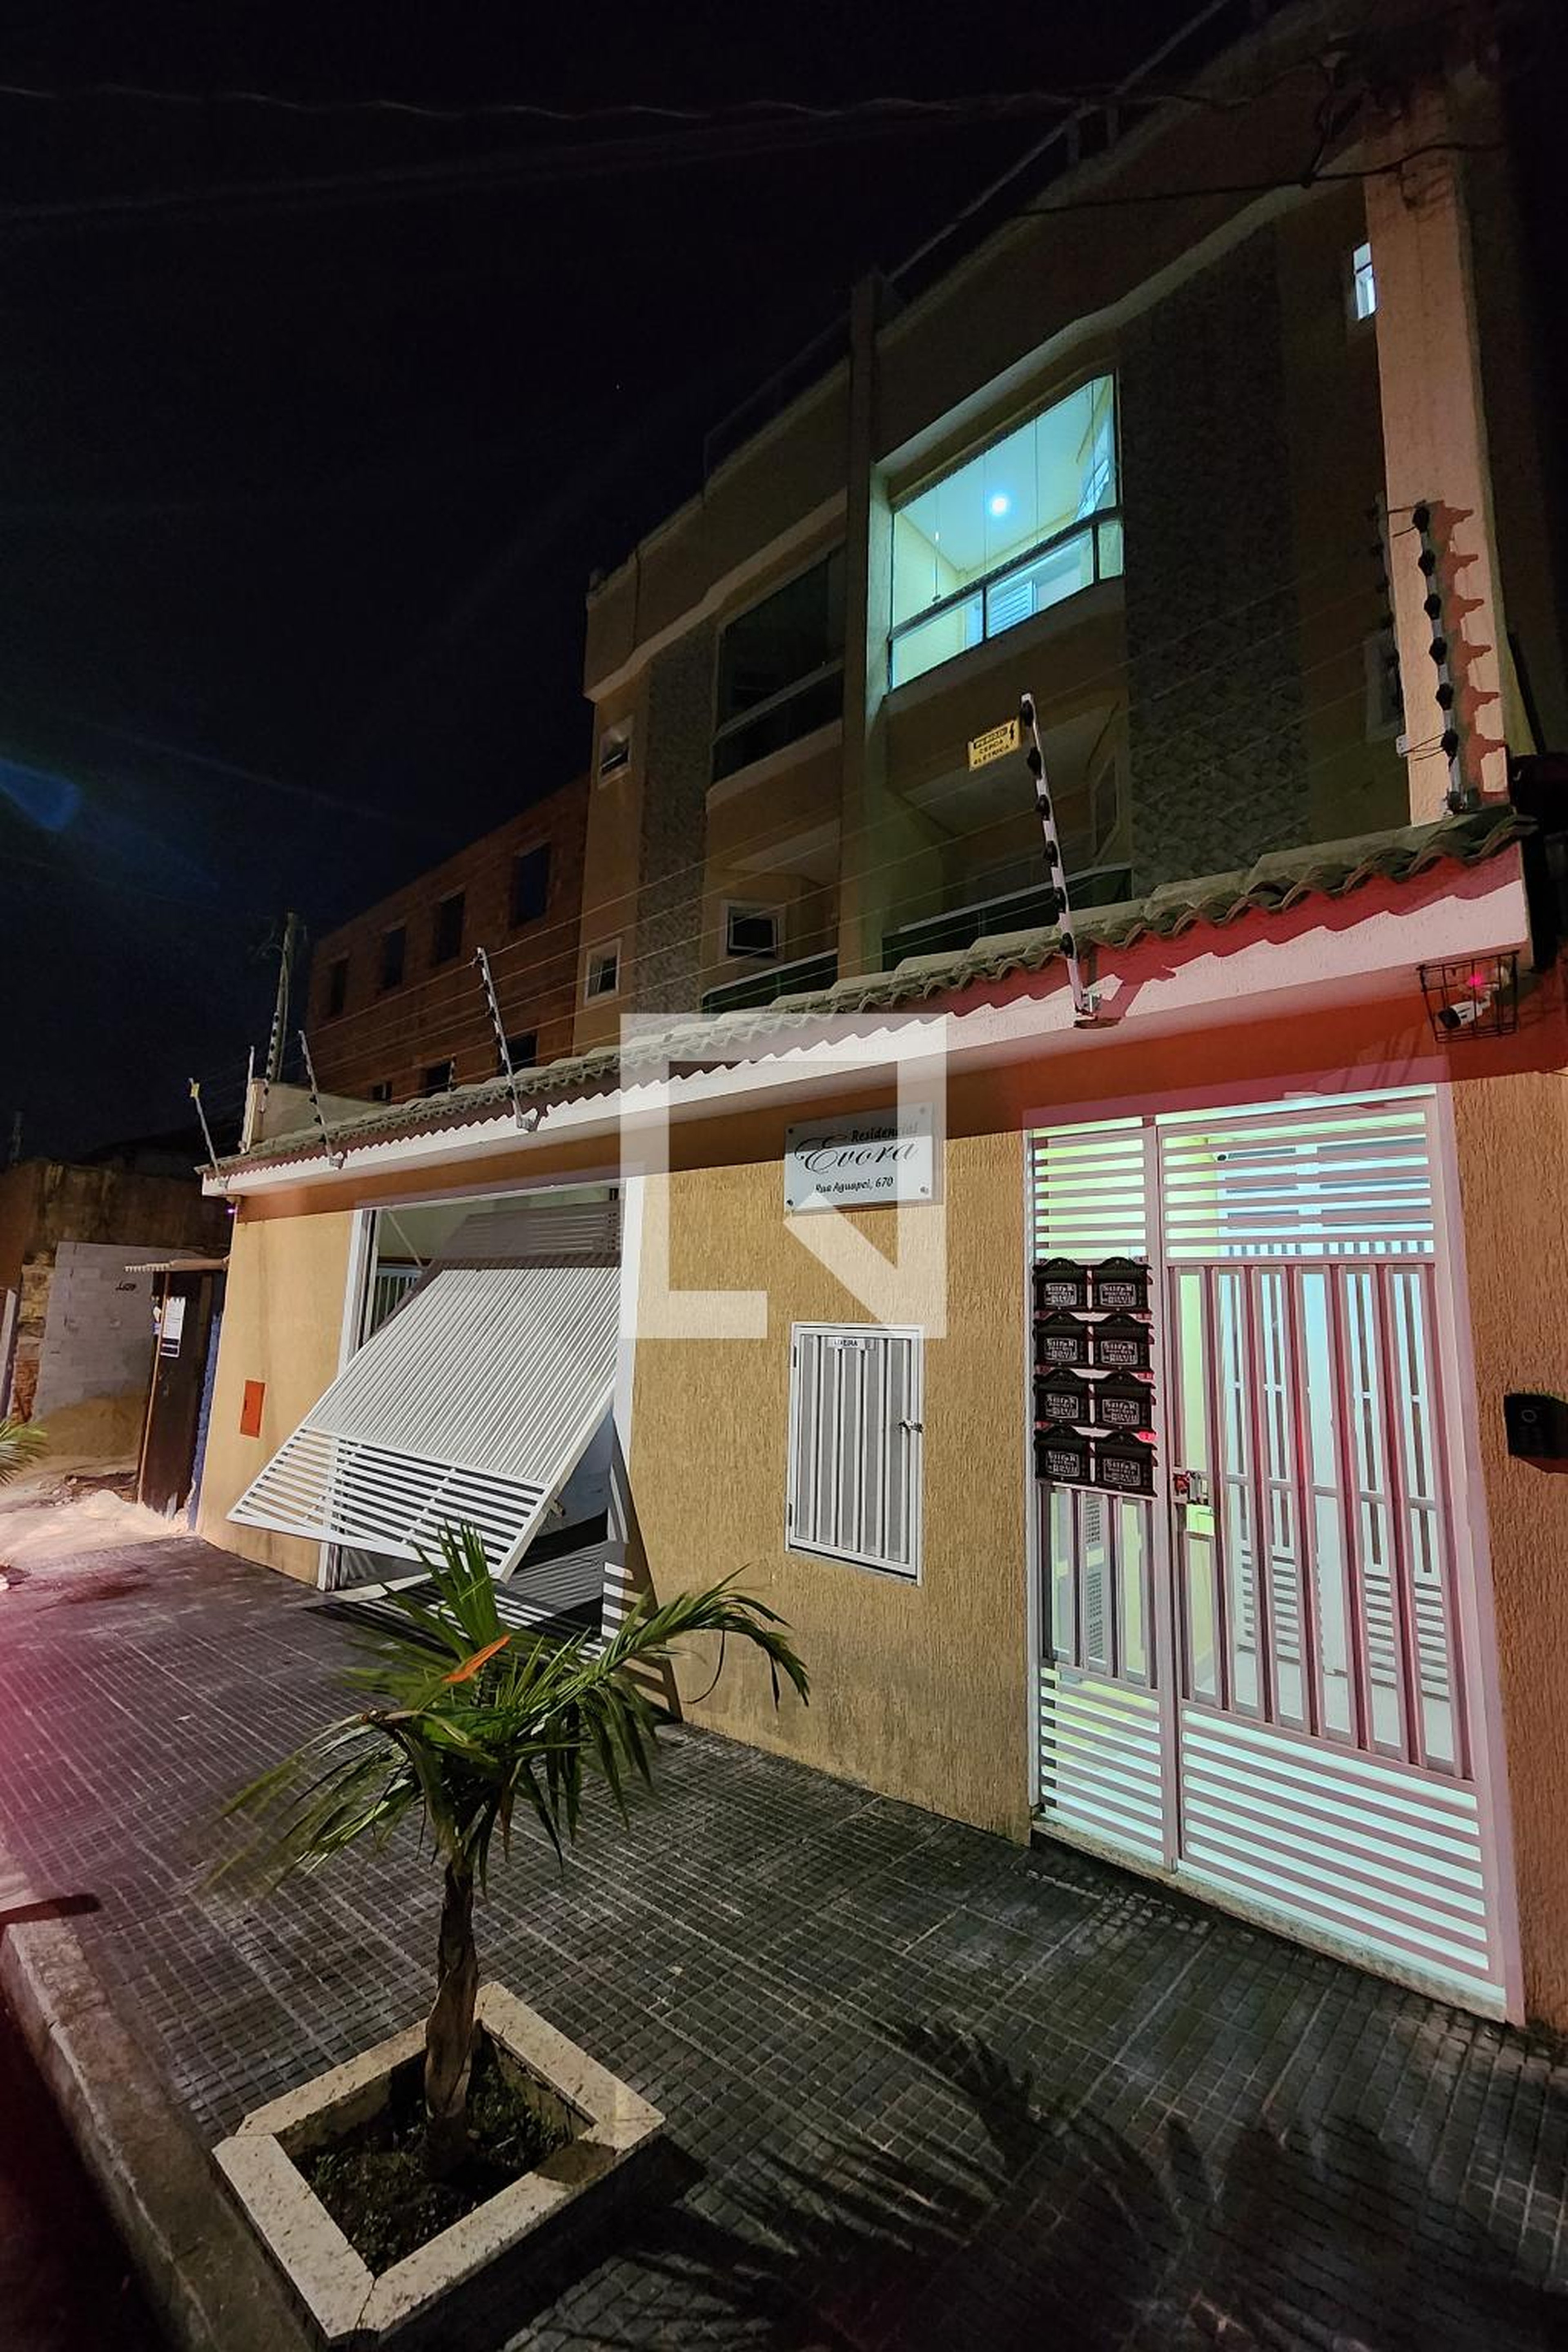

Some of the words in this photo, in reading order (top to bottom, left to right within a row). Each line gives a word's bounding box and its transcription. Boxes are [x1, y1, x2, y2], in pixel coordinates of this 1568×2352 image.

[851, 1122, 918, 1143] Residenial
[815, 1183, 832, 1193] Rua
[875, 1176, 894, 1188] 670
